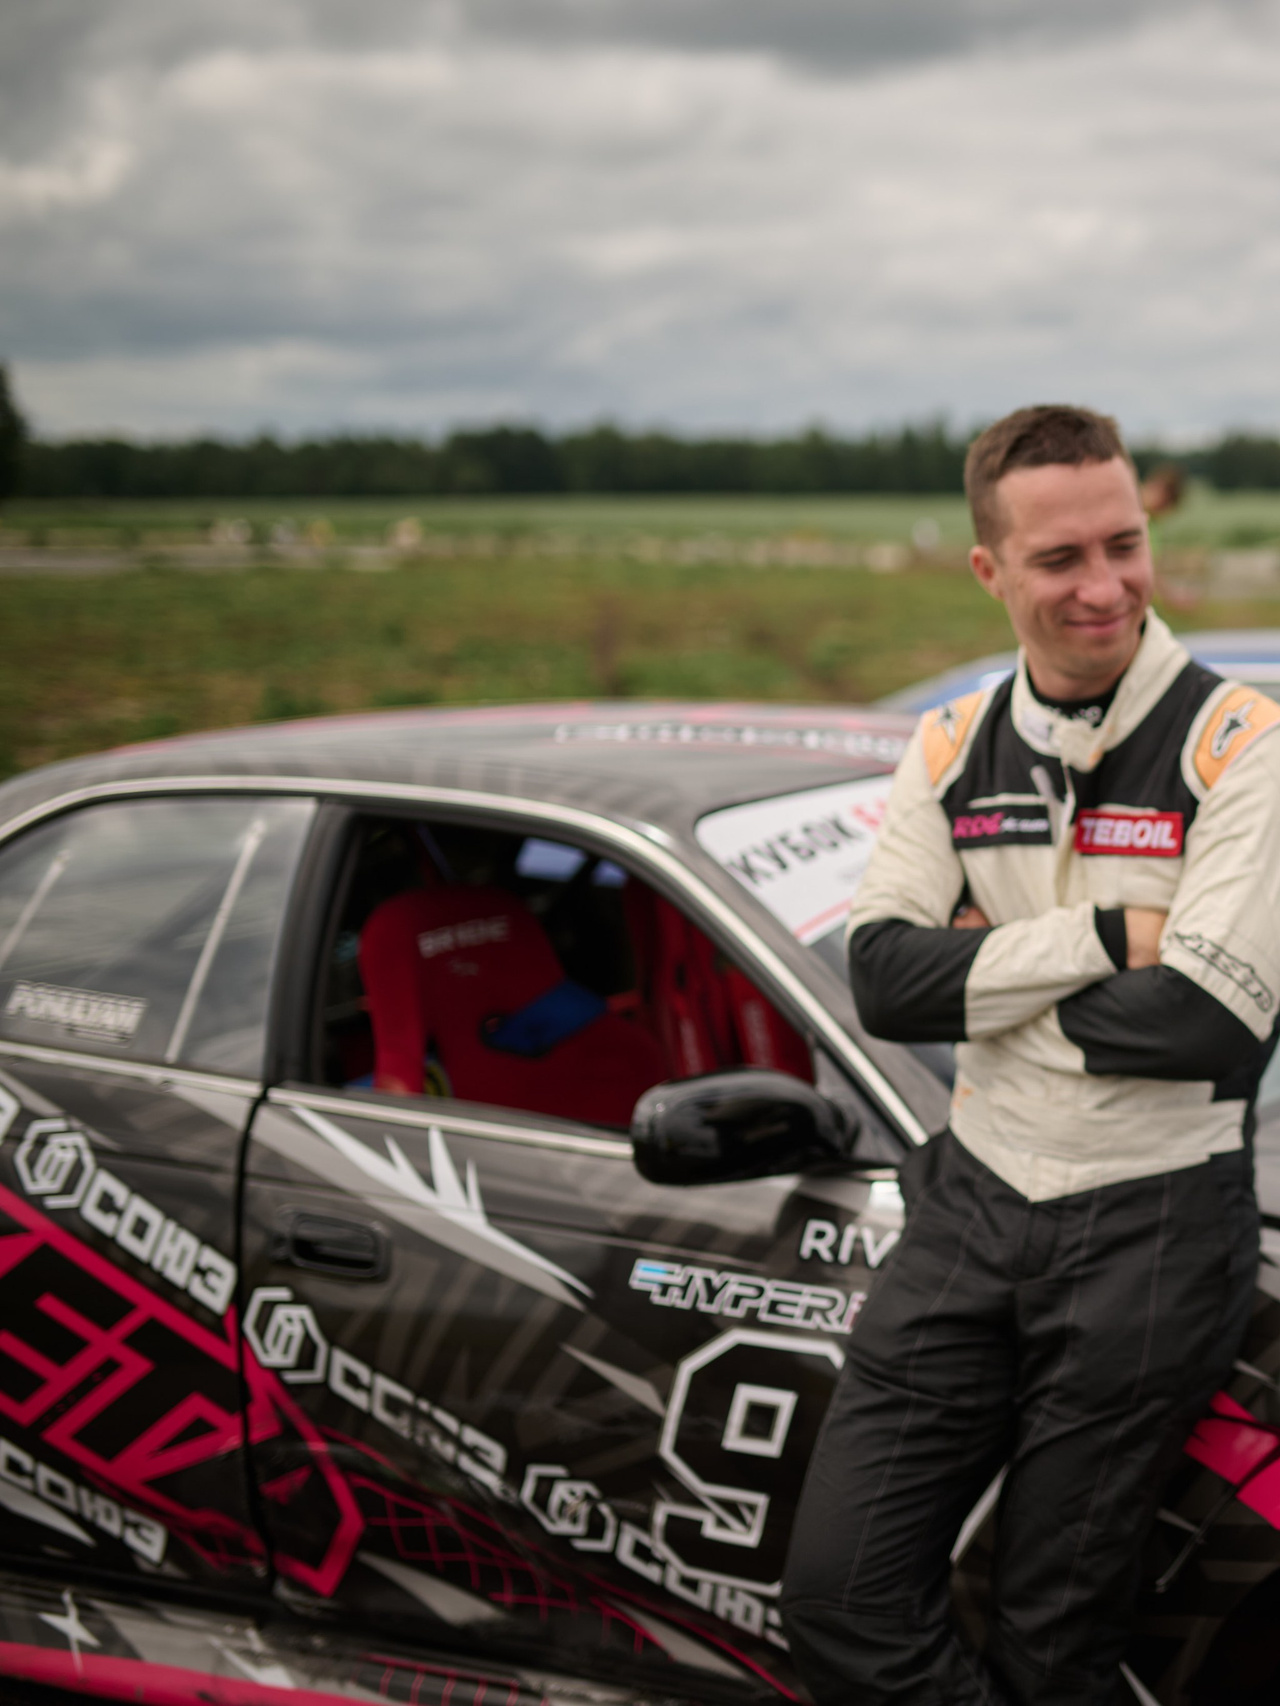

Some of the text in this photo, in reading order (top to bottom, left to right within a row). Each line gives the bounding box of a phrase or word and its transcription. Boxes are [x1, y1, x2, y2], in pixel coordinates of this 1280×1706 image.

[727, 812, 866, 889] КУБОК
[1079, 818, 1178, 850] TEBOIL
[80, 1168, 238, 1317] СОЮЗ
[0, 1436, 169, 1566] СОЮЗ
[659, 1327, 846, 1598] 9
